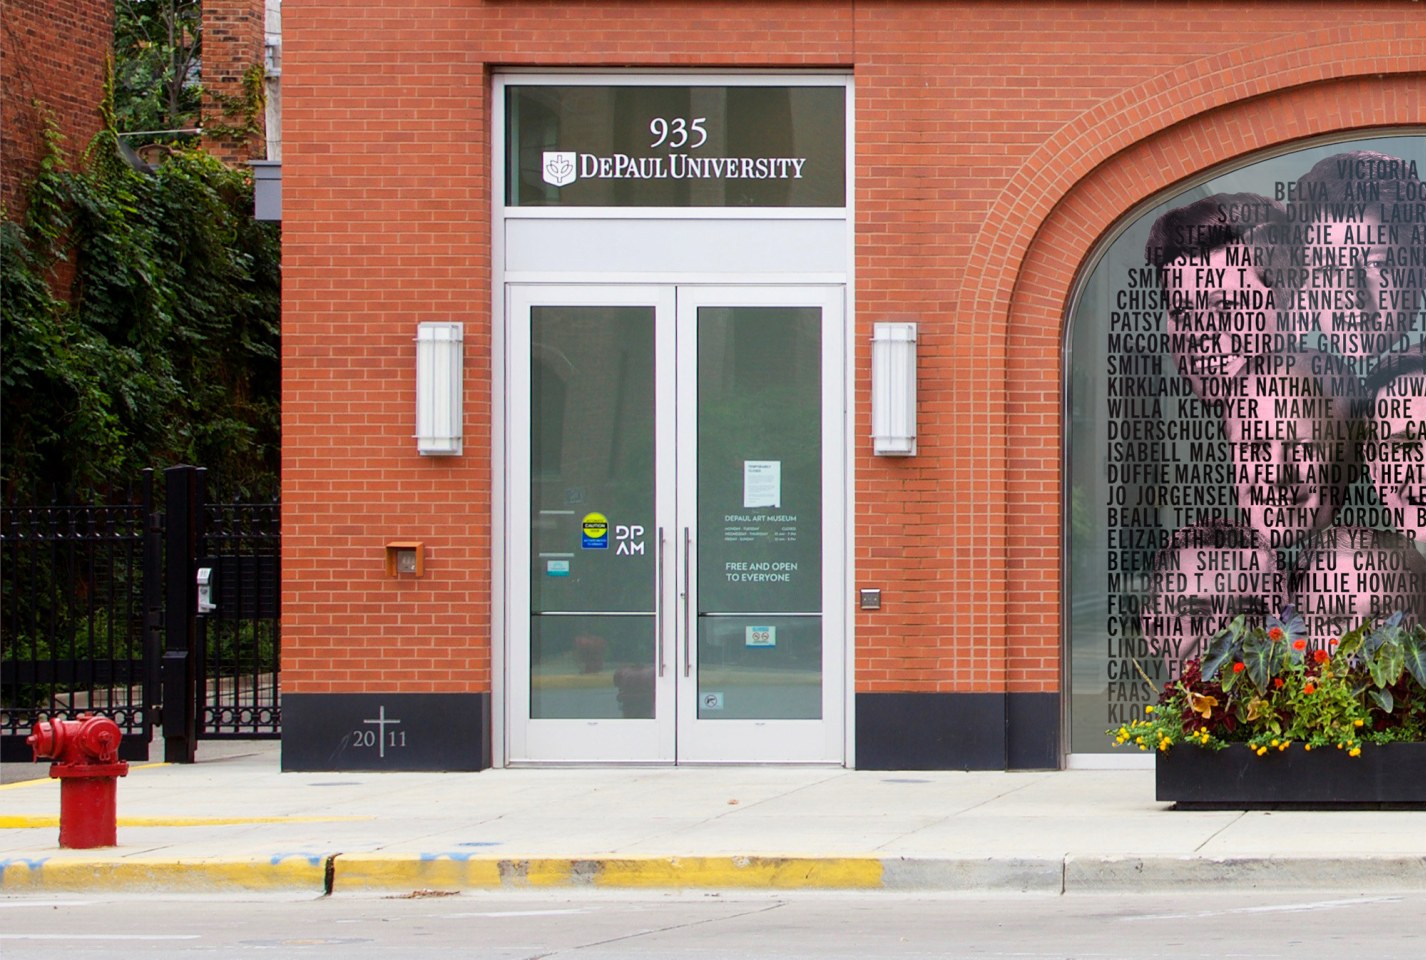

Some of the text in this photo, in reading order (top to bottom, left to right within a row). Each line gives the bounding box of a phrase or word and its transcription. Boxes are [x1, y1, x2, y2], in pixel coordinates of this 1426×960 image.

[649, 117, 708, 149] 935
[1337, 160, 1418, 180] VICTORIA
[1275, 181, 1328, 202] BELVA
[1344, 181, 1380, 202] ANN
[1217, 203, 1272, 223] SCOTT
[1286, 203, 1367, 223] DUNIWAY
[1268, 225, 1332, 245] GRACIE
[1344, 225, 1398, 245] ALLEN
[1225, 247, 1275, 267] MARY
[1290, 247, 1371, 267] KENNERY
[1128, 268, 1182, 289] SMITH
[1195, 268, 1225, 289] FAY
[1237, 268, 1251, 289] T.
[1263, 268, 1367, 289] CARPENTER
[1116, 290, 1209, 310] CHISHOLM
[1222, 290, 1276, 310] LINDA
[1288, 290, 1366, 310] JENNESS
[1110, 312, 1163, 332] PATSY
[1171, 312, 1266, 332] TAKAMOTO
[1276, 312, 1321, 332] MINK
[1108, 334, 1222, 354] MCCORMACK
[1231, 334, 1308, 354] DEIRDRE
[1317, 334, 1410, 354] GRISWOLD
[1107, 355, 1163, 376] SMITH
[1178, 355, 1229, 376] ALICE
[1245, 355, 1296, 376] TRIPP
[1108, 377, 1192, 398] KIRKLAND
[1200, 377, 1249, 398] TONIE
[1256, 377, 1323, 398] NATHAN
[1107, 399, 1163, 419] WILLA
[1178, 399, 1259, 419] KENOYER
[1274, 399, 1334, 419] MAMIE
[1351, 399, 1412, 419] MOORE
[1108, 421, 1227, 441] DOERSCHUCK
[1241, 421, 1297, 441] HELEN
[1312, 421, 1392, 441] HALYARD
[1107, 443, 1180, 463] ISABELL
[1190, 443, 1272, 463] MASTERS
[1281, 443, 1347, 463] TENNIE
[1355, 443, 1424, 463] ROGERS
[1107, 464, 1171, 485] DUFFIE
[1177, 464, 1249, 485] MARSHA
[1255, 464, 1346, 485] FEINLAND
[1351, 464, 1376, 485] DR.
[1107, 486, 1126, 506] JO
[1136, 486, 1239, 506] JORGENSEN
[1251, 486, 1299, 506] MARY
[1107, 508, 1163, 528] BEALL
[1175, 508, 1250, 528] TEMPLIN
[1263, 508, 1319, 528] CATHY
[1332, 508, 1404, 528] GORDON
[1108, 530, 1204, 550] ELIZABETH
[1214, 530, 1260, 550] DOLE
[1271, 530, 1337, 550] DORIAN
[726, 562, 798, 571] FREE AND OPEN
[1108, 551, 1180, 572] BEEMAN
[1197, 551, 1260, 572] SHEILA
[1277, 551, 1337, 572] BILYEU
[1353, 551, 1411, 572] CAROL
[726, 573, 790, 582] TO EVERYONE
[1108, 573, 1187, 593] MILDRED
[1195, 573, 1207, 593] T.
[1215, 573, 1283, 593] GLOVER
[1290, 573, 1350, 593] MILLIE
[1108, 595, 1198, 615] FLORENCE
[1211, 595, 1282, 615] WALKER
[1296, 595, 1357, 615] ELAINE
[1107, 617, 1183, 637] CYNTHIA
[1108, 638, 1181, 659] LINDSAY
[1108, 682, 1150, 702] FAAS
[353, 730, 406, 747] 20 11
